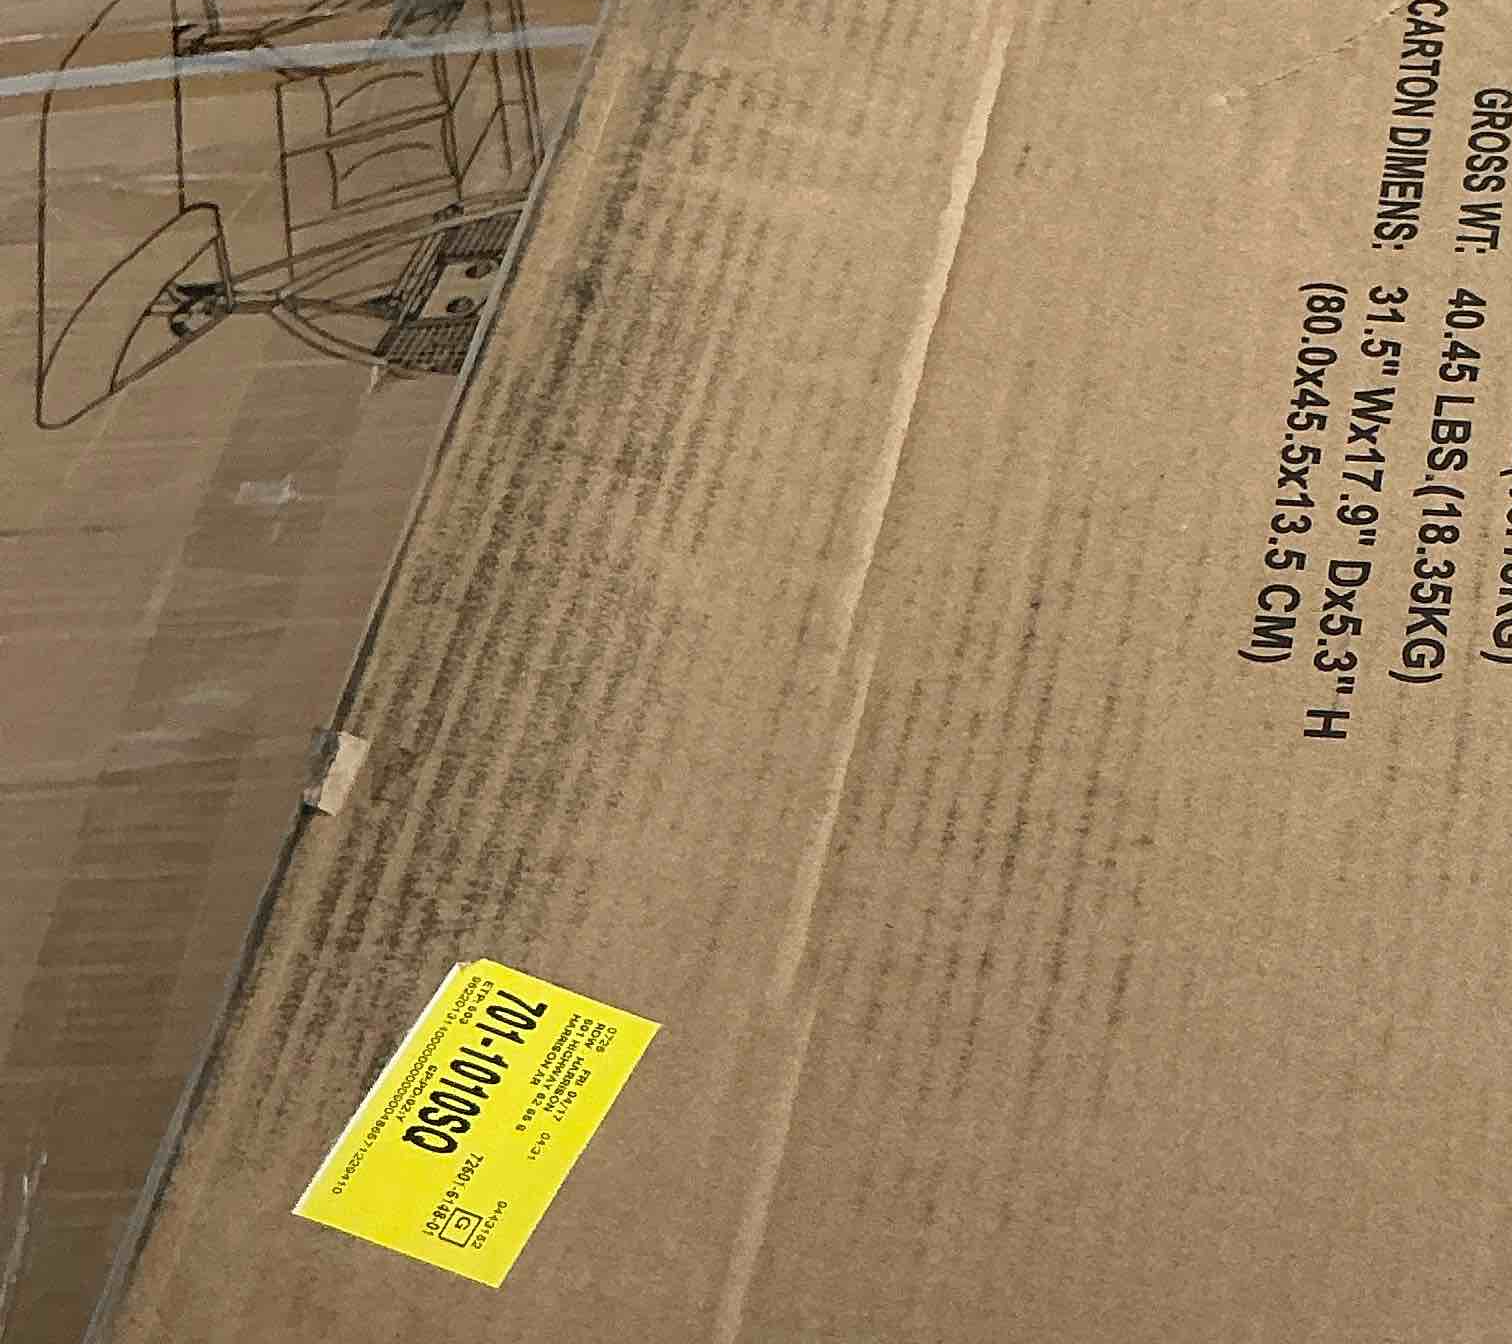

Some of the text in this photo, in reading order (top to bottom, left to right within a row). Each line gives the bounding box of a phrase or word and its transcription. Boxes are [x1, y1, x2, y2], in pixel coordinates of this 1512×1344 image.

[1371, 124, 1433, 251] DIMENS:
[1454, 202, 1504, 256] WT:
[1359, 283, 1411, 378] 31.5"
[1437, 287, 1488, 385] 40.45
[1336, 386, 1397, 550] Wx17.9"
[1237, 583, 1302, 666] CM)
[1311, 558, 1373, 697] Dx5.3"
[1388, 482, 1466, 687] (18.35KG)
[1303, 706, 1351, 740] H
[401, 988, 550, 1155] 701-1010SQ
[540, 1013, 582, 1070] HARRISON
[543, 1055, 585, 1113] HARRISON
